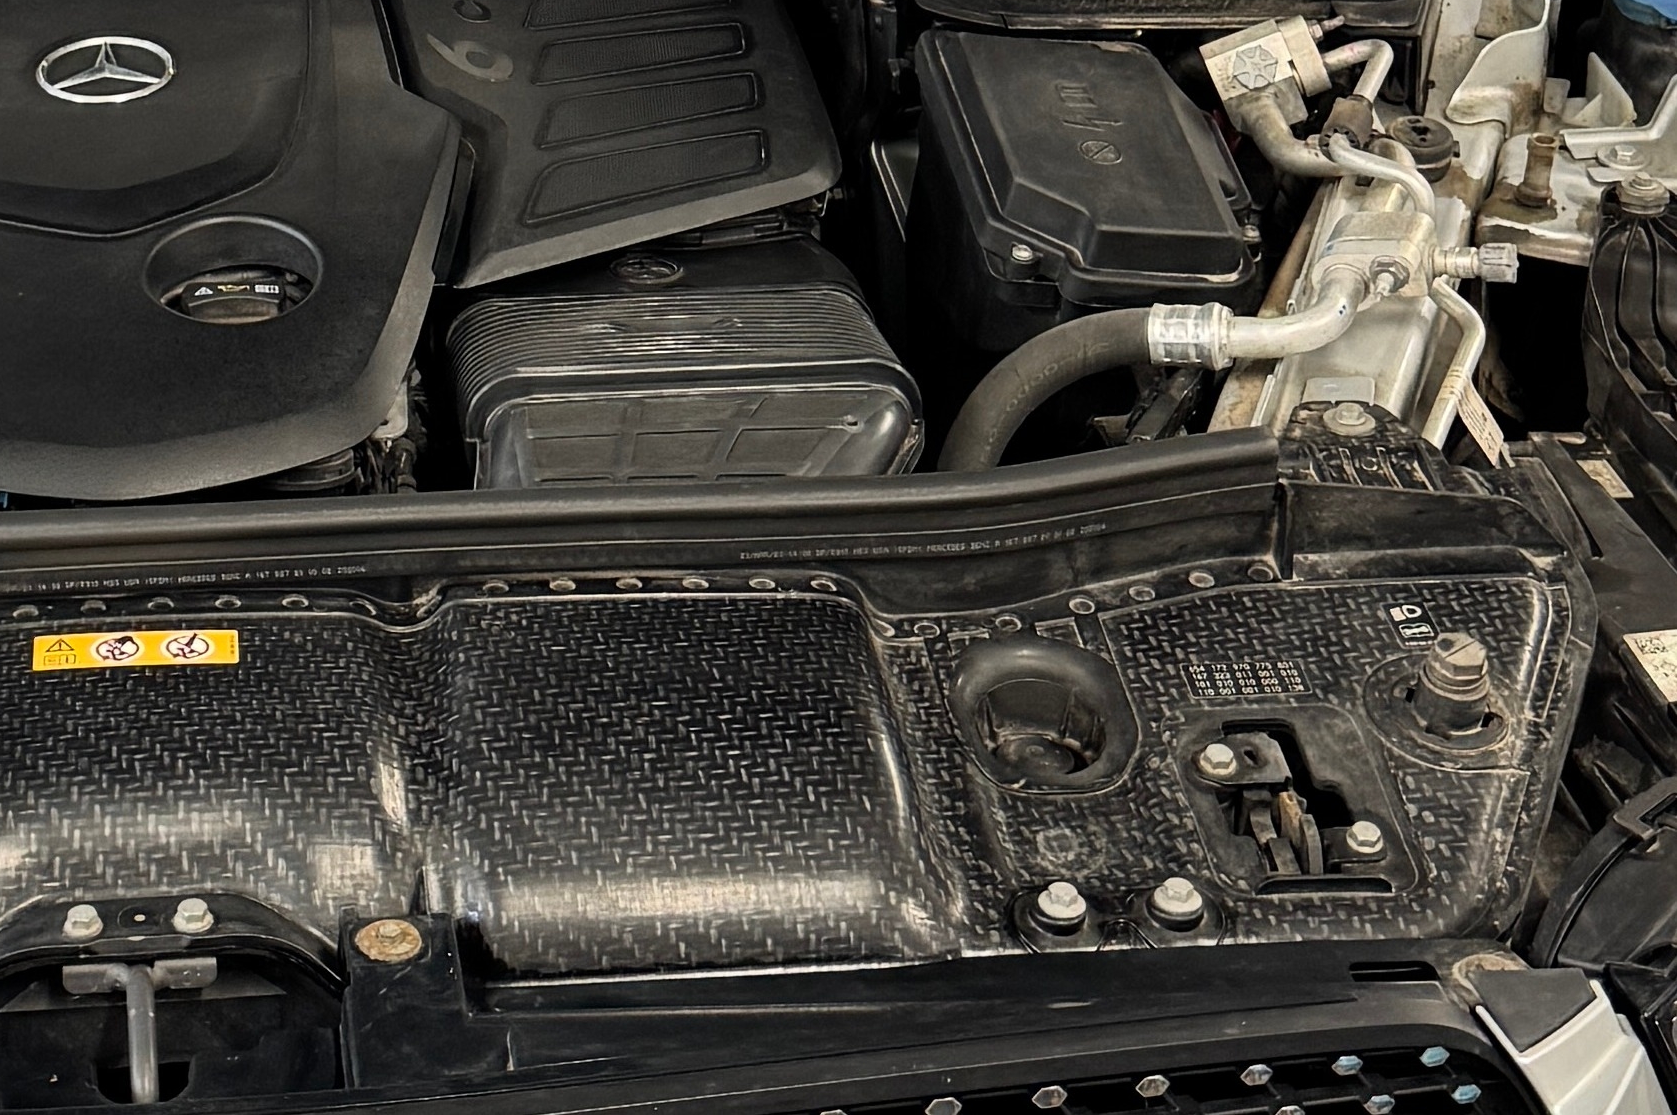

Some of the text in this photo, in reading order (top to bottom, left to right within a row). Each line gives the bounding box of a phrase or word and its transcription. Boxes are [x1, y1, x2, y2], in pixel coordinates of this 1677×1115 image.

[426, 33, 514, 82] 6
[1192, 672, 1208, 680] 167
[1235, 671, 1253, 679] 011
[1195, 680, 1211, 688] 101
[1216, 679, 1234, 687] 010
[1238, 678, 1256, 686] 010
[1284, 676, 1301, 684] 110
[1198, 688, 1215, 696] 110
[1219, 688, 1237, 696] 001
[1264, 685, 1282, 693] 010
